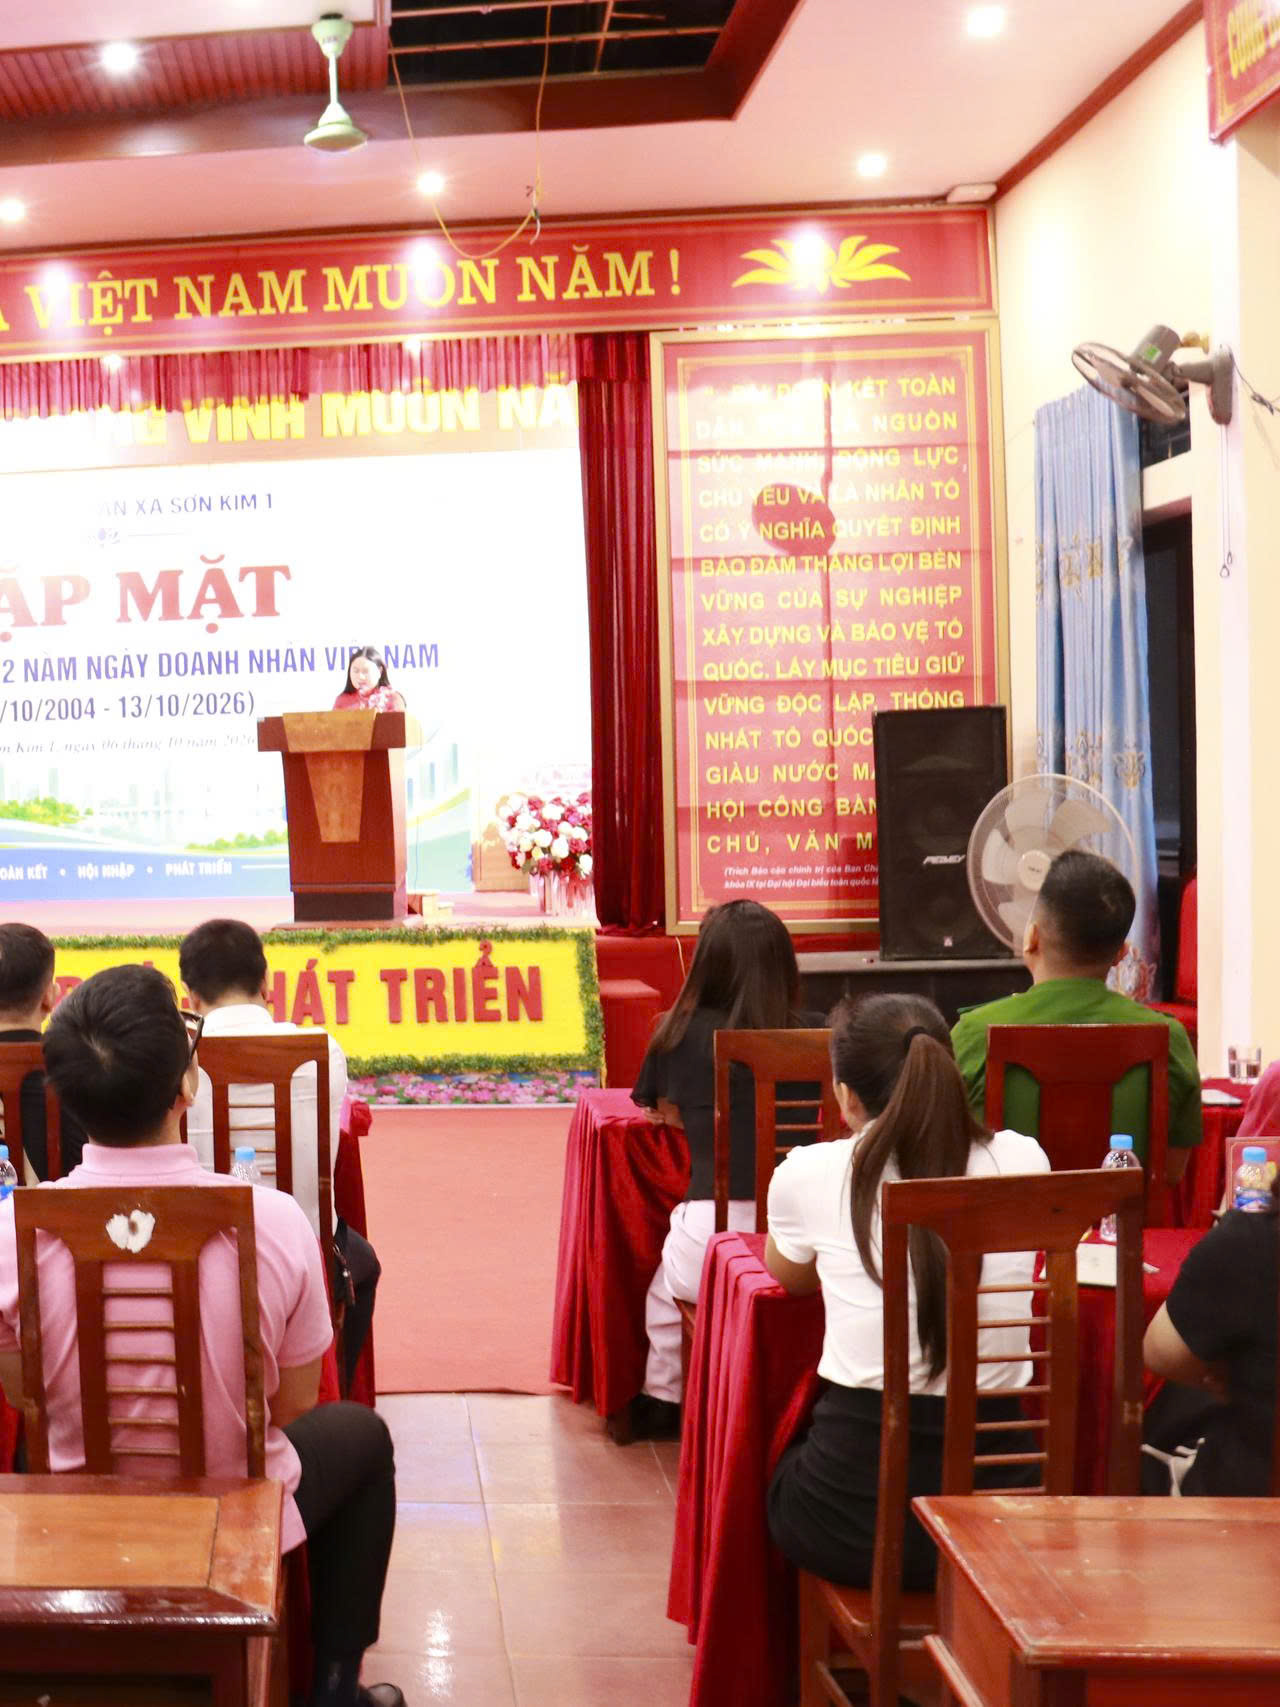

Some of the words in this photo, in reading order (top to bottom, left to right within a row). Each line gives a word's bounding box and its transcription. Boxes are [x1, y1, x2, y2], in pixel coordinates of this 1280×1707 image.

[25, 272, 157, 335] VIỆT
[175, 268, 308, 319] NAM
[516, 245, 654, 301] NĂM
[898, 374, 955, 396] TOÀN
[914, 446, 958, 469] LỰC
[220, 494, 257, 511] KIM
[265, 493, 272, 509] 1
[759, 517, 825, 540] NGHĨA
[116, 554, 291, 634] MẶT
[817, 621, 845, 643] VÀ
[159, 650, 239, 677] DOANH
[384, 643, 439, 669] NAM
[822, 659, 867, 681] MỤC
[119, 691, 255, 719] 13/10/2026)
[706, 763, 759, 784] GIÀU
[773, 759, 838, 783] NƯỚC
[787, 828, 838, 851] VĂN
[380, 939, 543, 1024] TRIỂN
